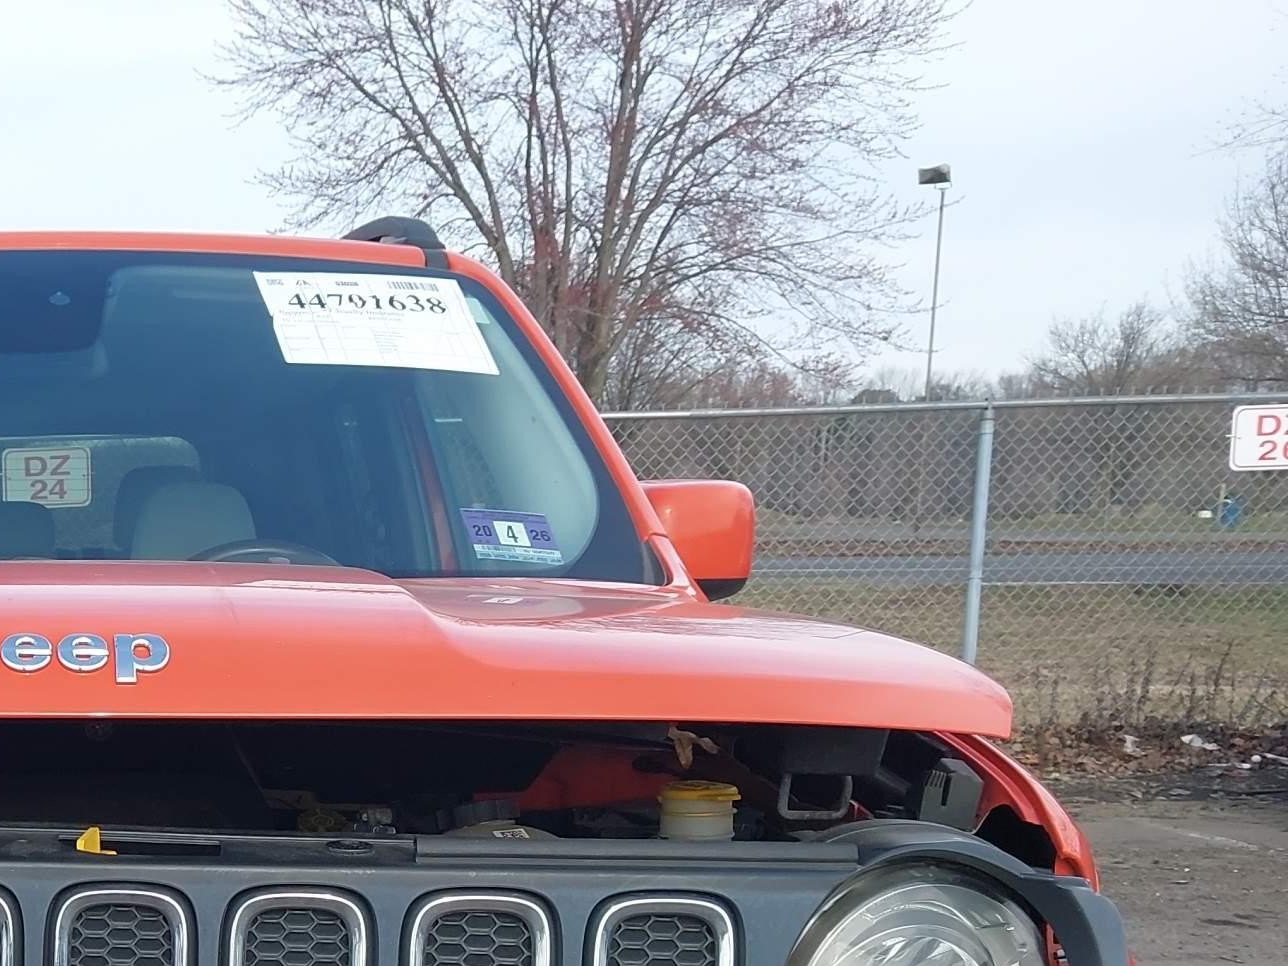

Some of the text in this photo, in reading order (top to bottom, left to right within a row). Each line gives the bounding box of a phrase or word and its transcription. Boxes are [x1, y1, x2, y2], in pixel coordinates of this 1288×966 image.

[23, 454, 71, 477] DZ
[30, 479, 67, 500] 24
[472, 524, 551, 543] 20 4 26
